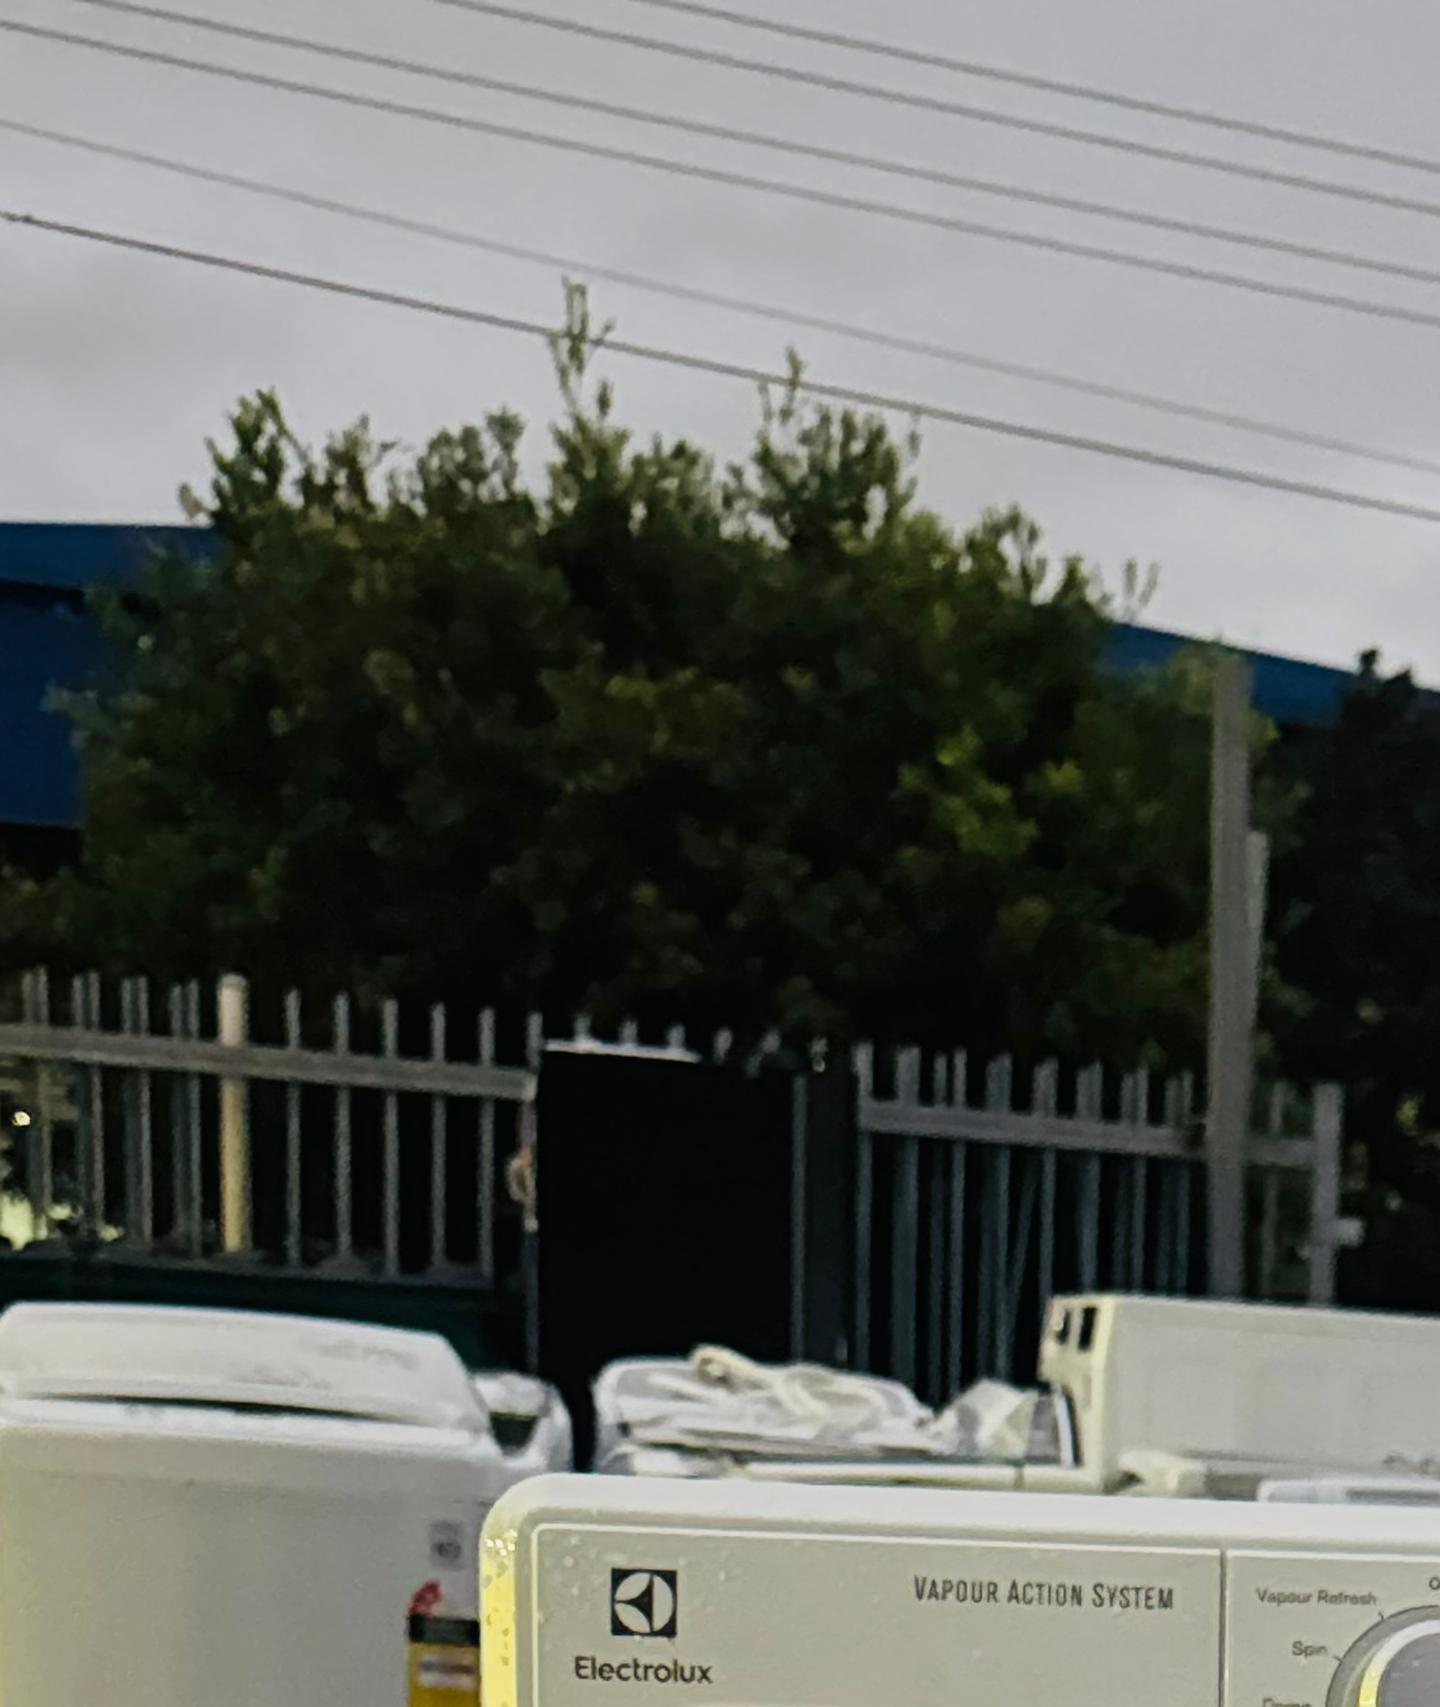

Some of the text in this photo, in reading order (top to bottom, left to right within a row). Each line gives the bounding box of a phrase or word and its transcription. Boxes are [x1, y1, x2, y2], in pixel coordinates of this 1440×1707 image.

[914, 1576, 1174, 1610] VAPOUR ACTION SYSTEM
[1256, 1588, 1377, 1607] Vapour Refresh
[1292, 1642, 1327, 1659] Spin
[574, 1656, 713, 1685] Electrolux
